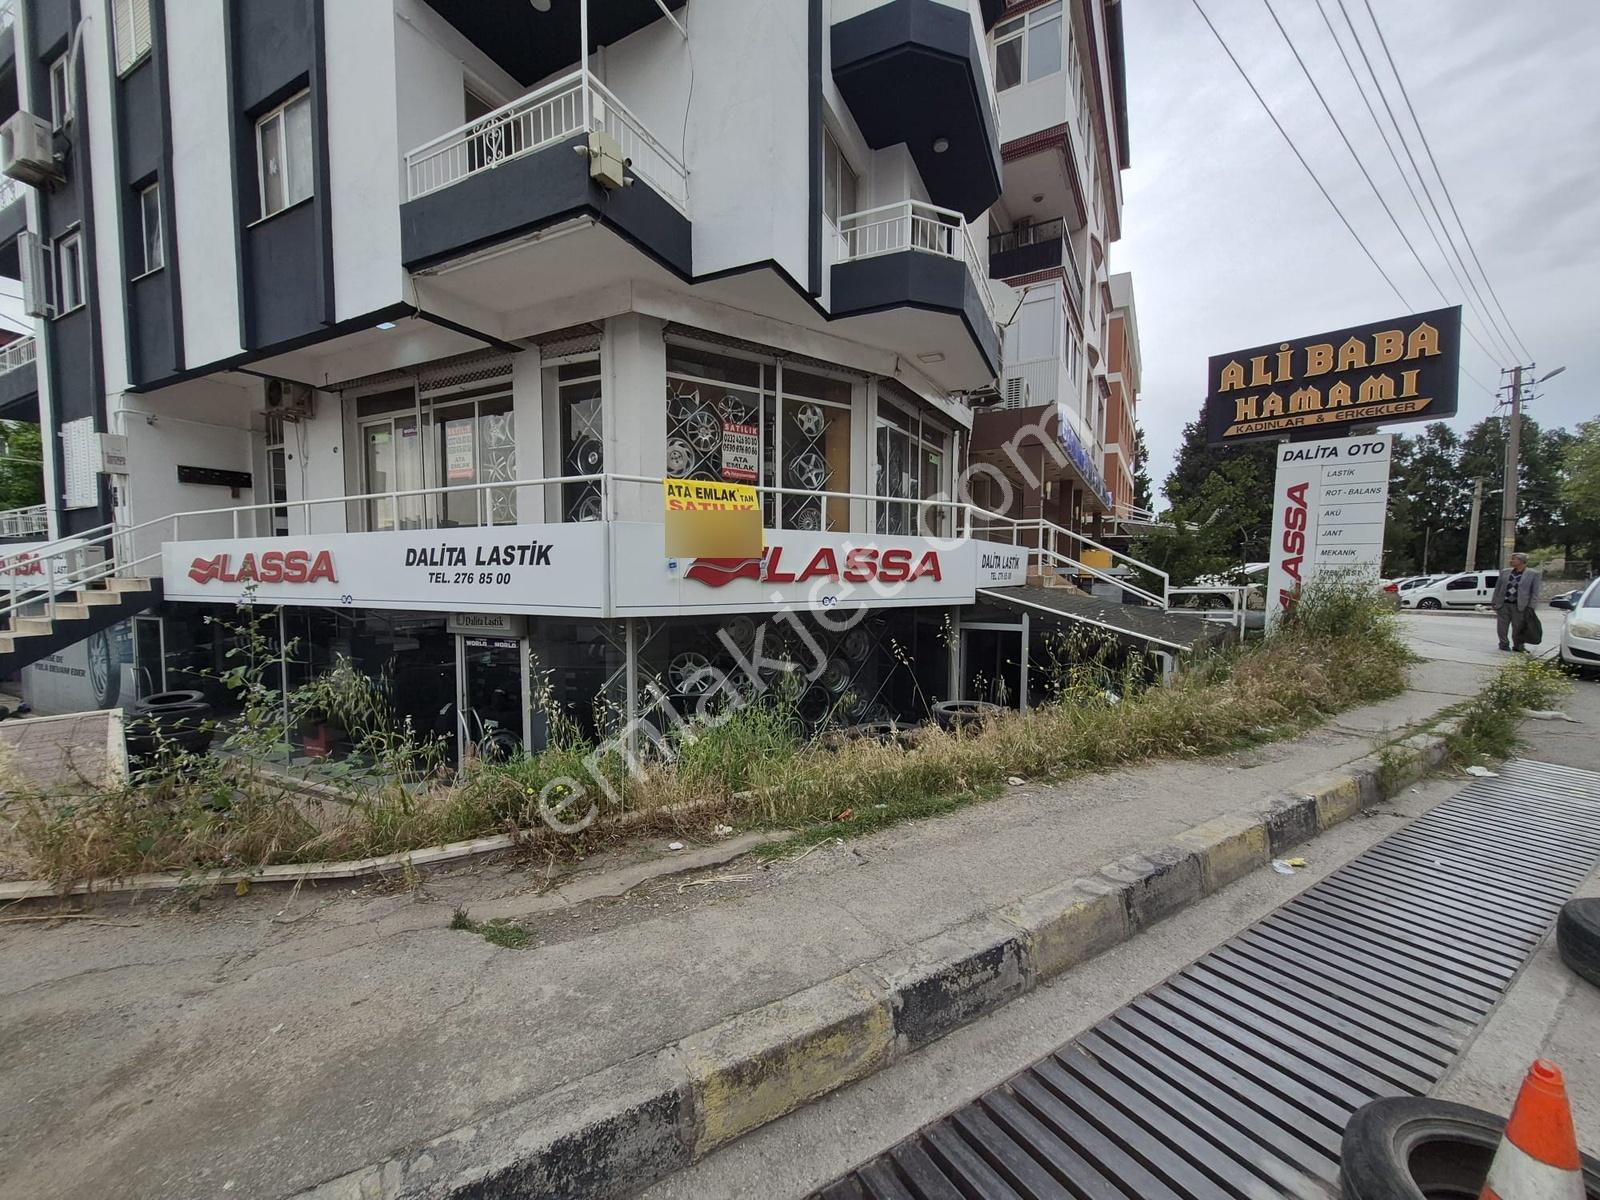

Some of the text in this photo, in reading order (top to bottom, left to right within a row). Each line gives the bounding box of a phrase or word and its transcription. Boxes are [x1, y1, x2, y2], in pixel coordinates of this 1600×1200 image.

[1217, 321, 1443, 394] ALİ BABA
[1233, 368, 1421, 423] HAMAMI
[1236, 401, 1416, 434] KADINLAR & ERKEKLER
[724, 424, 757, 435] SATILIK
[1282, 442, 1386, 463] DALİTA OTO
[726, 462, 754, 471] EMLAK
[1326, 468, 1356, 478] LASTİK
[668, 484, 692, 498] ATA
[740, 494, 755, 503] TAN
[1325, 488, 1343, 498] ROT
[1347, 486, 1382, 497] BALANS
[1280, 481, 1310, 602] LASSA
[1321, 529, 1344, 538] JANT
[405, 540, 554, 568] DALİTA LASTİK
[982, 552, 1001, 569] DALİTA
[1320, 547, 1358, 557] MEKANİK
[219, 550, 338, 584] LASSA
[763, 546, 943, 584] LASSA
[428, 572, 511, 585] TEL. 276 85 00
[465, 615, 504, 627] Dalita Lastik
[494, 641, 517, 649] WORLD
